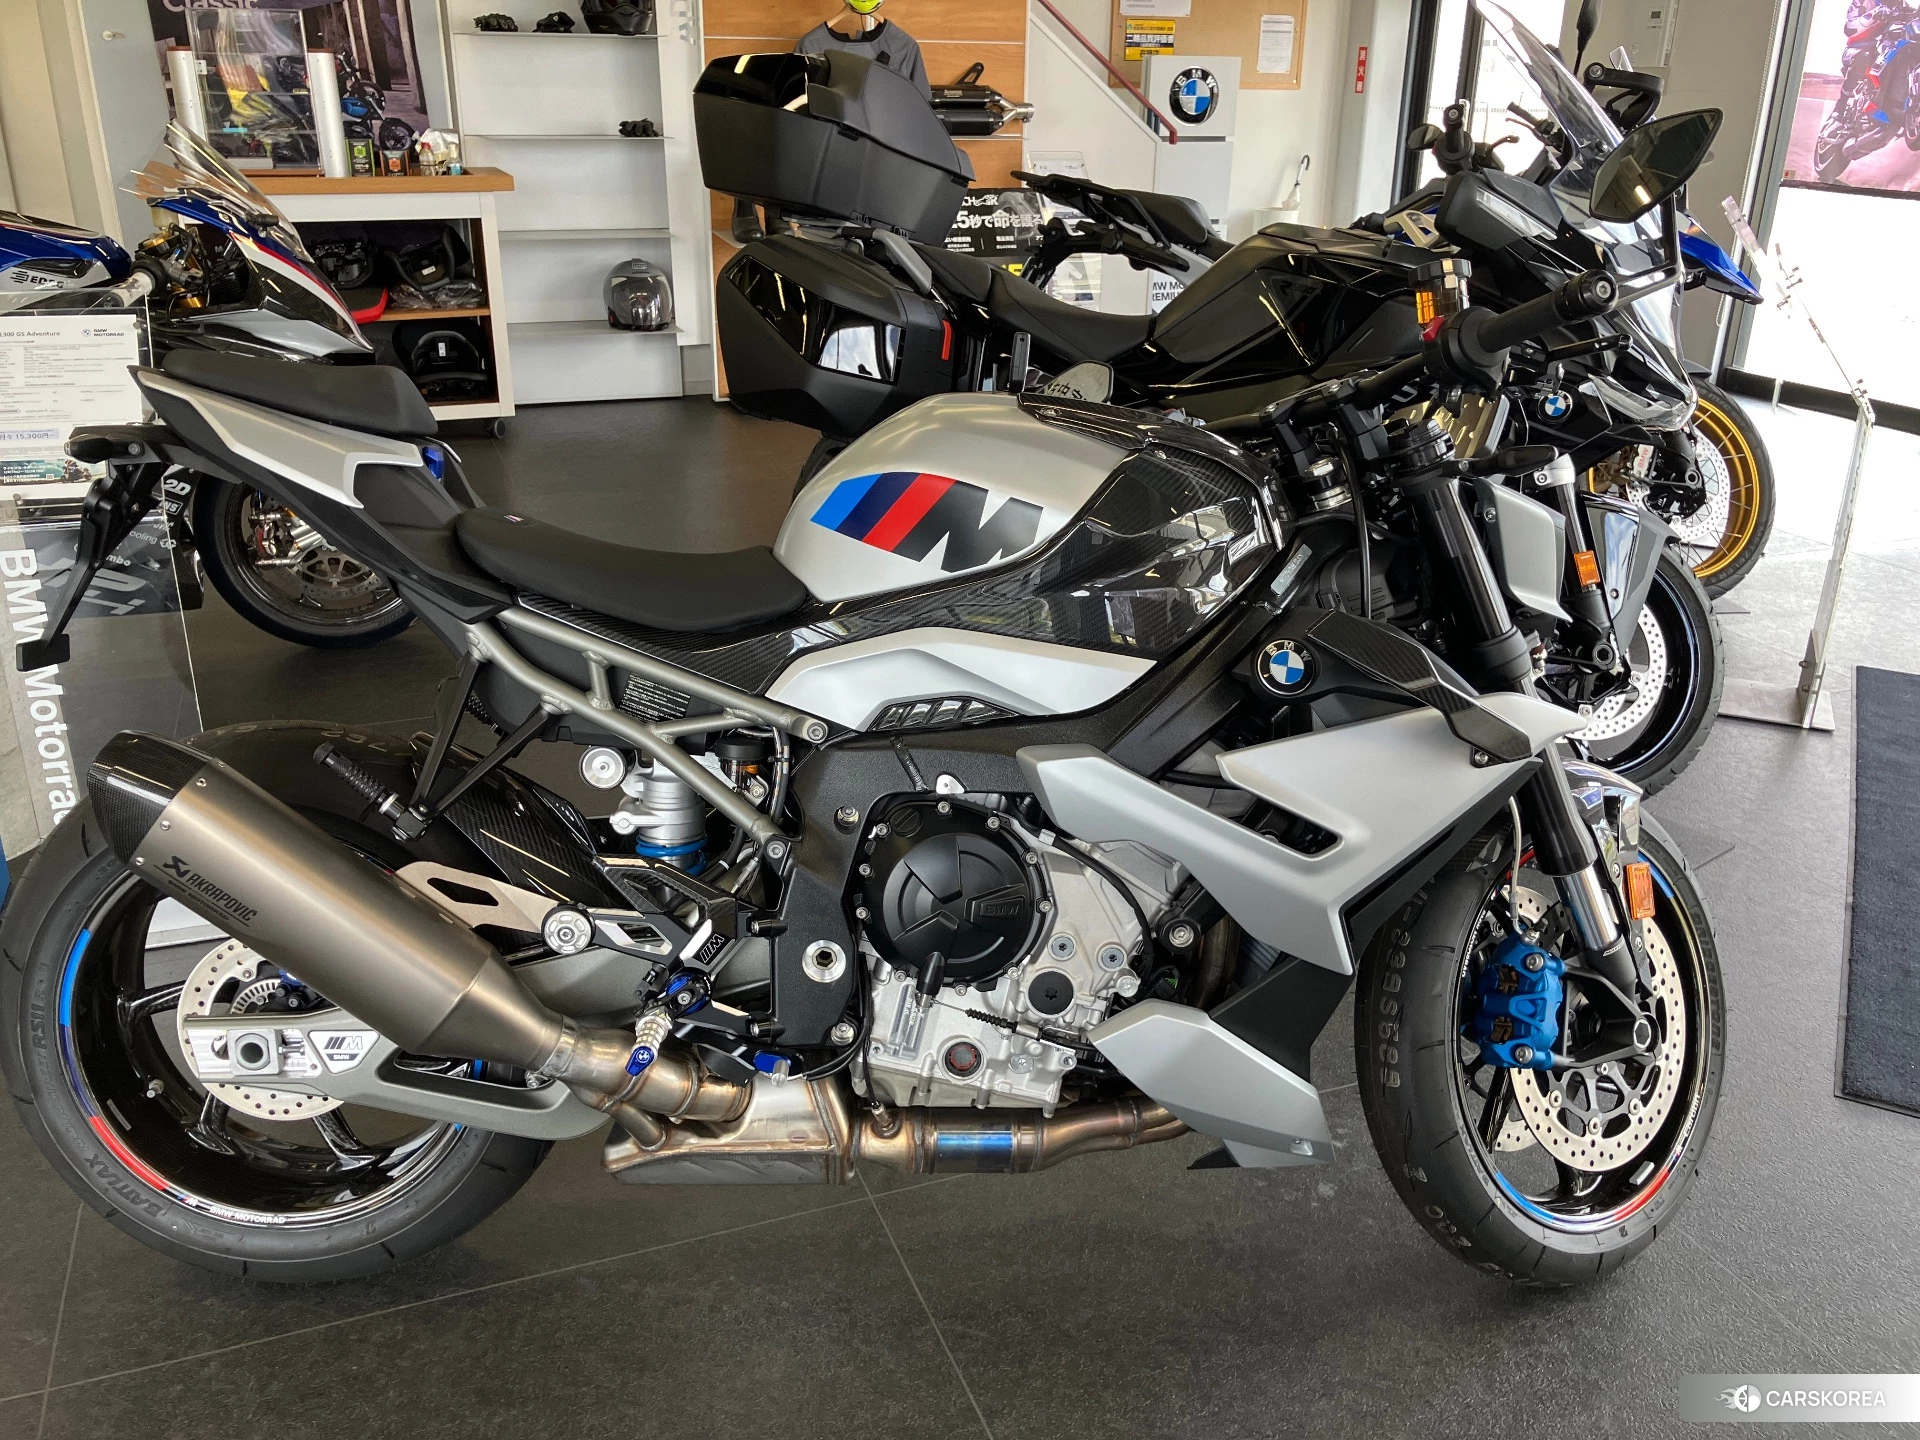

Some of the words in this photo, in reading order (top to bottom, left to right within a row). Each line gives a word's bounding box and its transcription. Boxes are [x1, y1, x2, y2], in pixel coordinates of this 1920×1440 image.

[1176, 69, 1216, 88] BMW
[1265, 641, 1312, 662] BMW
[209, 1205, 233, 1218] BMW
[233, 1212, 286, 1224] MOTORRAD
